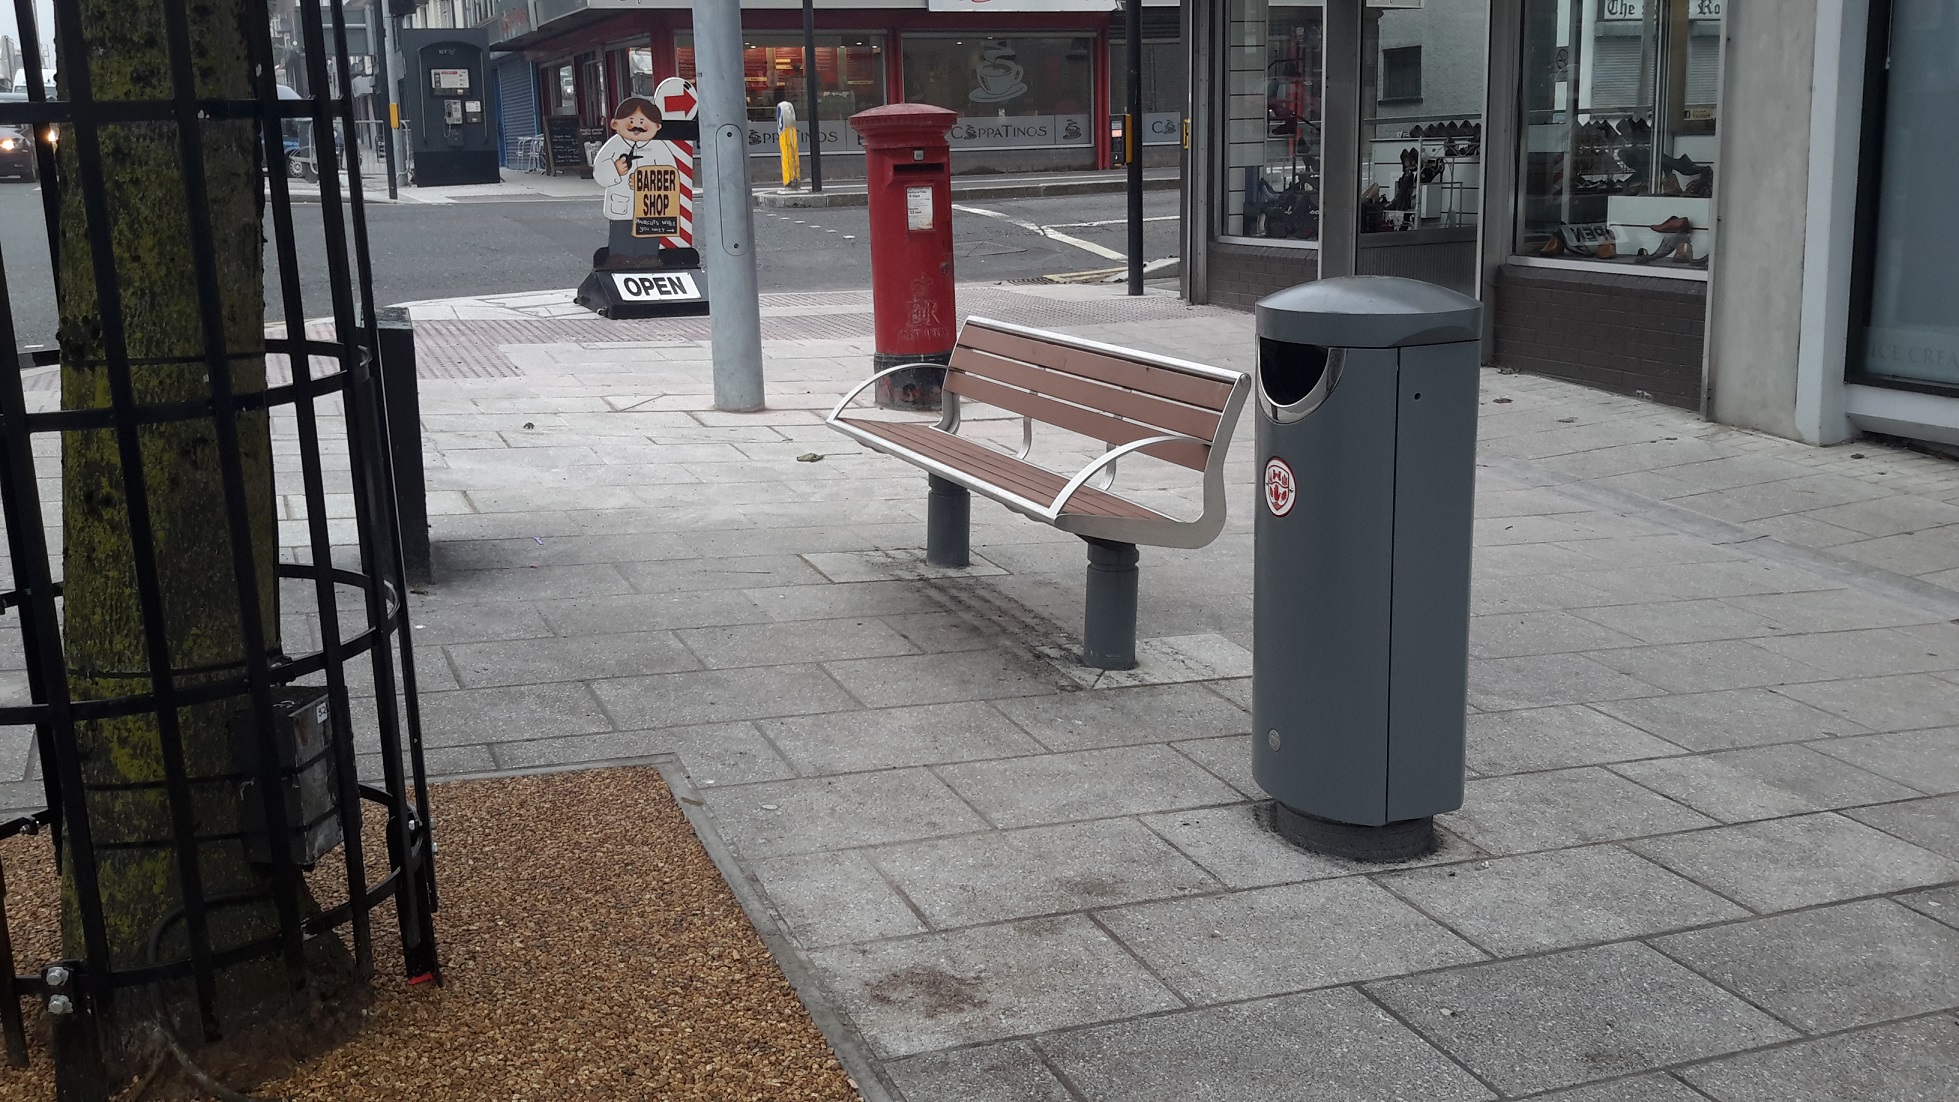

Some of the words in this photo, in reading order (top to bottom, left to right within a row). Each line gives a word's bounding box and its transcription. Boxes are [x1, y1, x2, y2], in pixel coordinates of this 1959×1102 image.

[1607, 0, 1635, 18] The
[637, 170, 676, 191] BARBER
[643, 194, 669, 216] SHOP
[623, 276, 688, 297] OPEN
